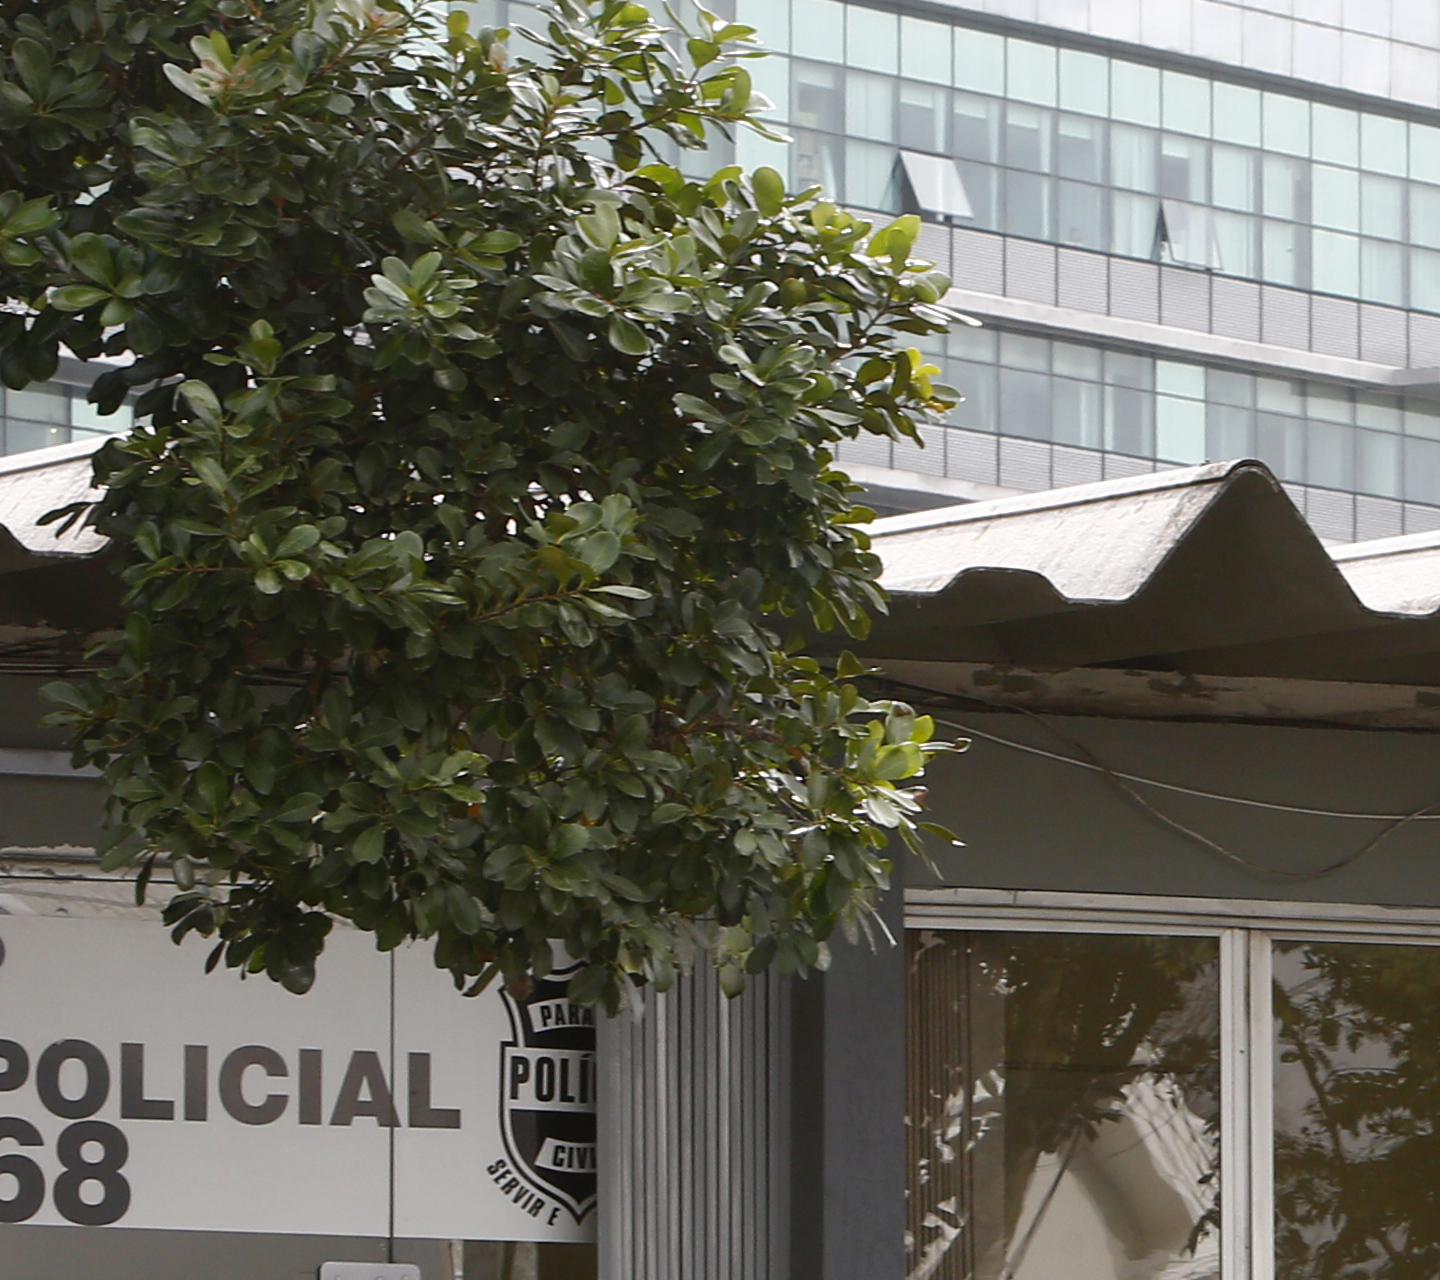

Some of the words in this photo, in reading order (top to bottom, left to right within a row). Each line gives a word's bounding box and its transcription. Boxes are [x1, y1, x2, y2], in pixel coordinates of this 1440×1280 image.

[510, 1052, 596, 1104] POLÍ
[486, 1158, 545, 1218] SERVIR
[546, 1207, 561, 1226] E
